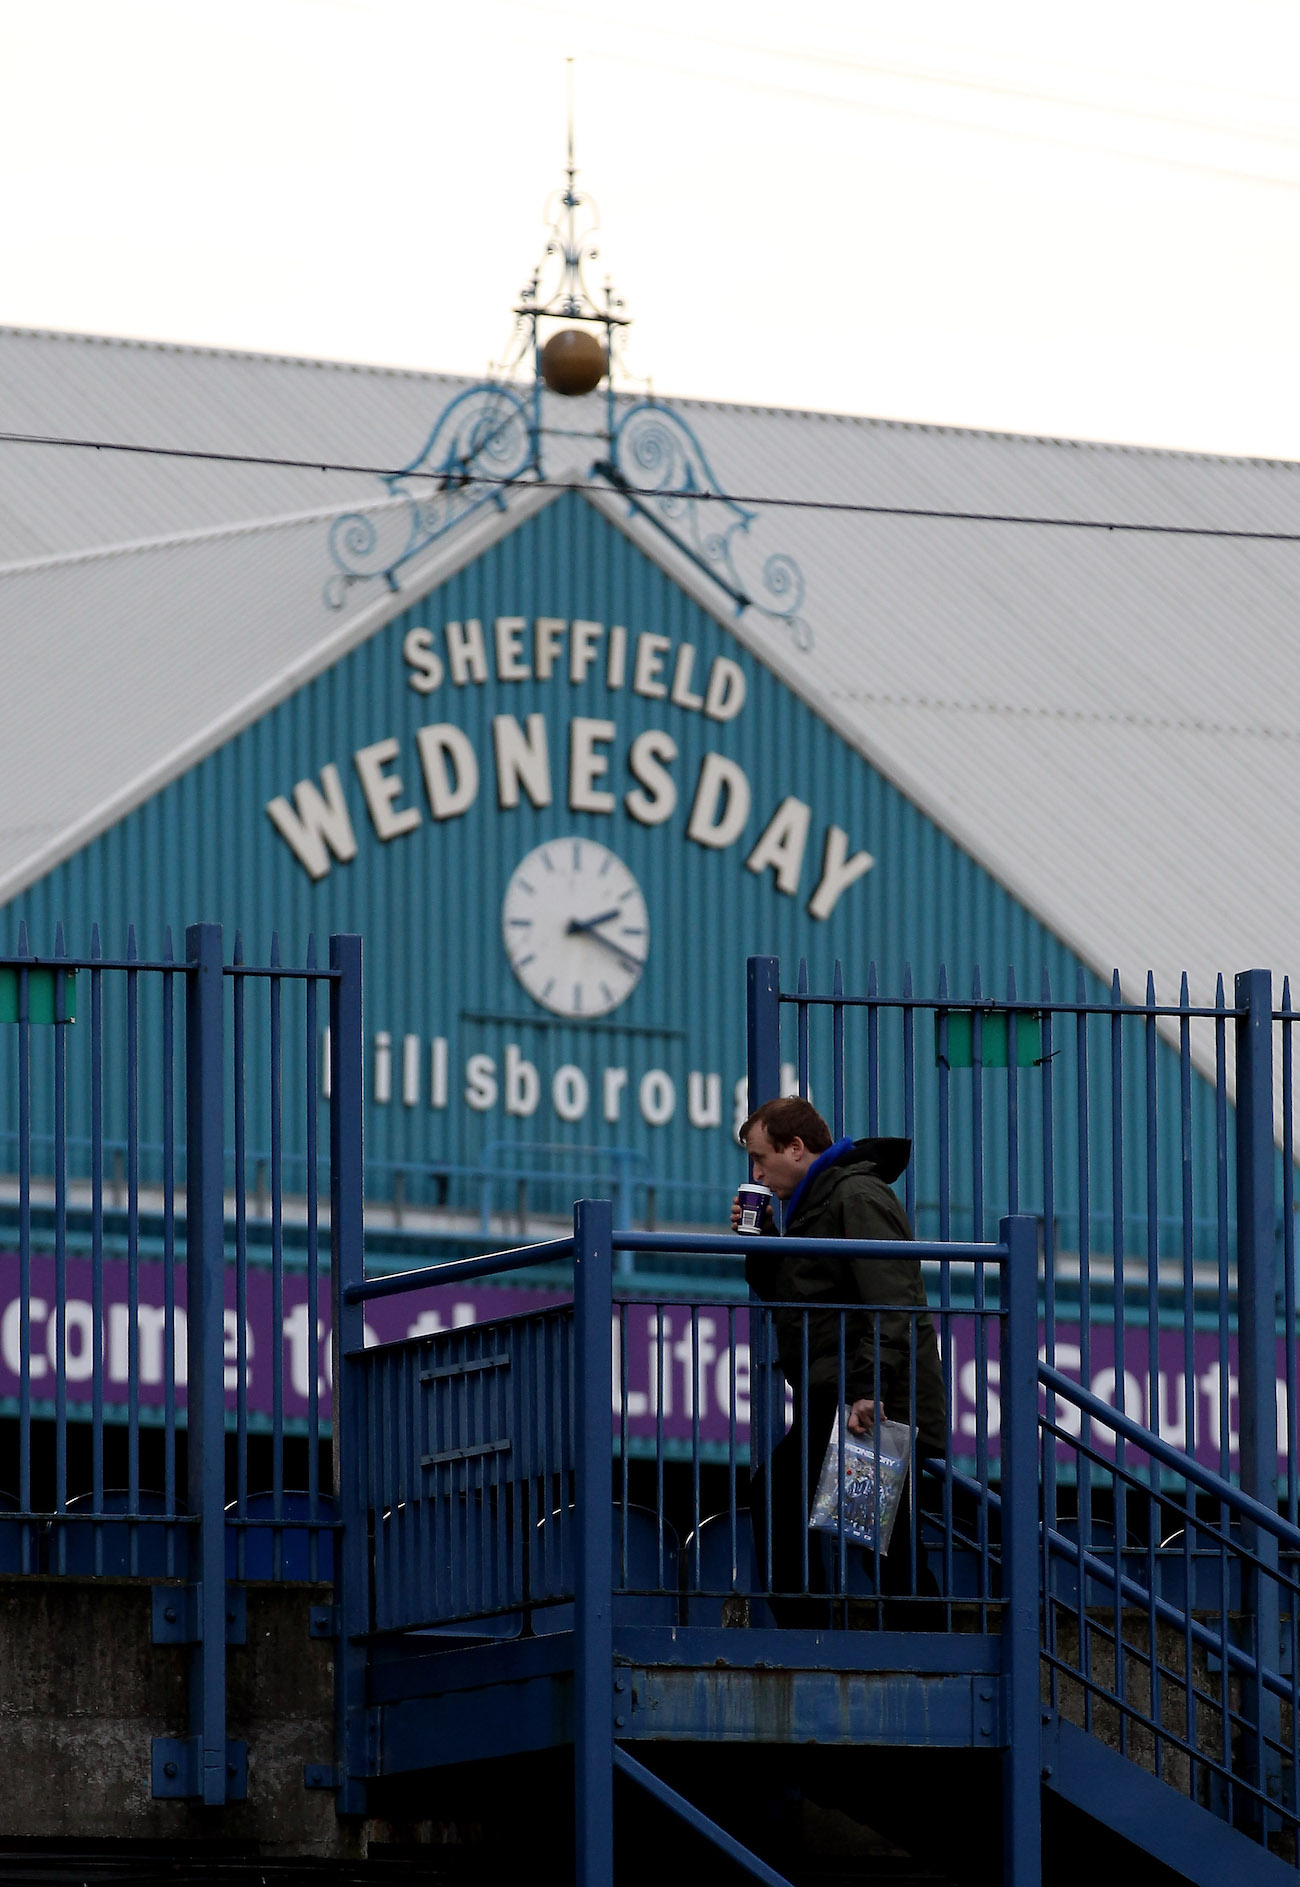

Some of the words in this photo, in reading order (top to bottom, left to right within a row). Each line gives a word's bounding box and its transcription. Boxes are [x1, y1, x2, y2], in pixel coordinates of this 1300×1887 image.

[403, 617, 746, 721] SHEFFIELD
[266, 712, 875, 920] WEDNESDAY
[322, 1026, 813, 1147] illsborou
[844, 1441, 896, 1467] EDNEAY
[1037, 1343, 1288, 1456] Sout
